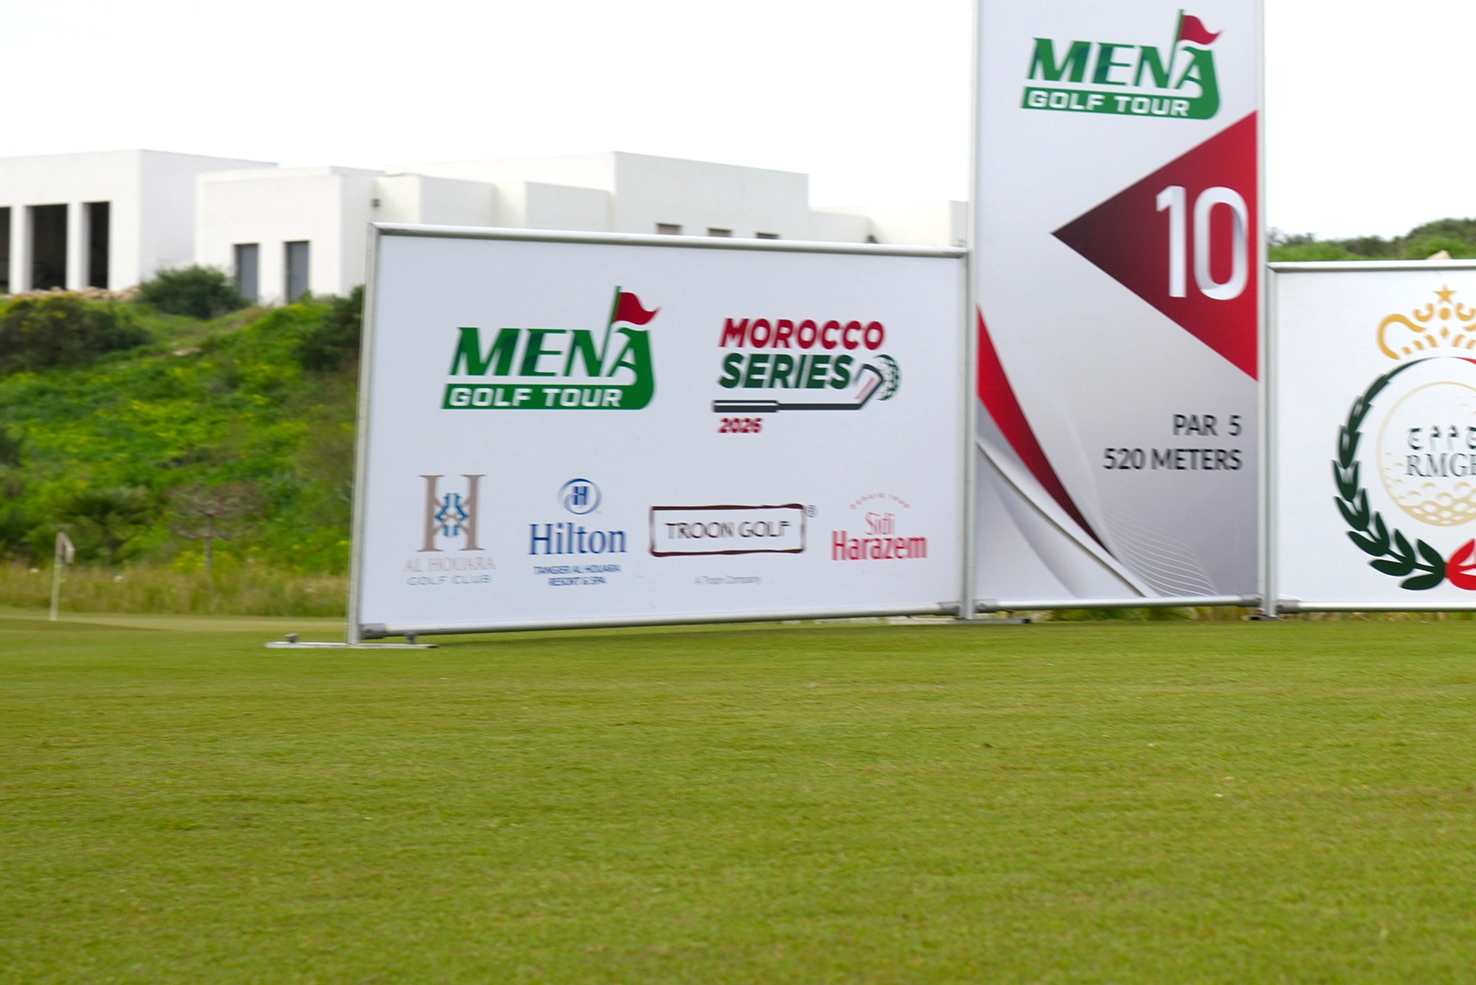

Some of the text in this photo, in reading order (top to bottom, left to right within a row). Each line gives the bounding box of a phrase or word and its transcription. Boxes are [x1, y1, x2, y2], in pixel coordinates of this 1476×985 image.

[1026, 36, 1219, 91] MENA
[1027, 90, 1190, 117] GOLF TOUR
[1156, 185, 1249, 301] 10
[719, 317, 886, 351] MOROCCO
[448, 325, 656, 379] MENA
[717, 352, 855, 390] SERIES
[448, 387, 623, 408] GOLF TOUR
[718, 417, 763, 434] 2026
[1172, 414, 1242, 437] PAR 5
[1102, 447, 1243, 471] 520 METERS
[664, 520, 791, 540] TROON GOLF
[864, 512, 896, 535] Sidi
[528, 522, 628, 555] Hilton
[832, 530, 927, 561] Harazem
[406, 574, 492, 586] GOLF CLUB
